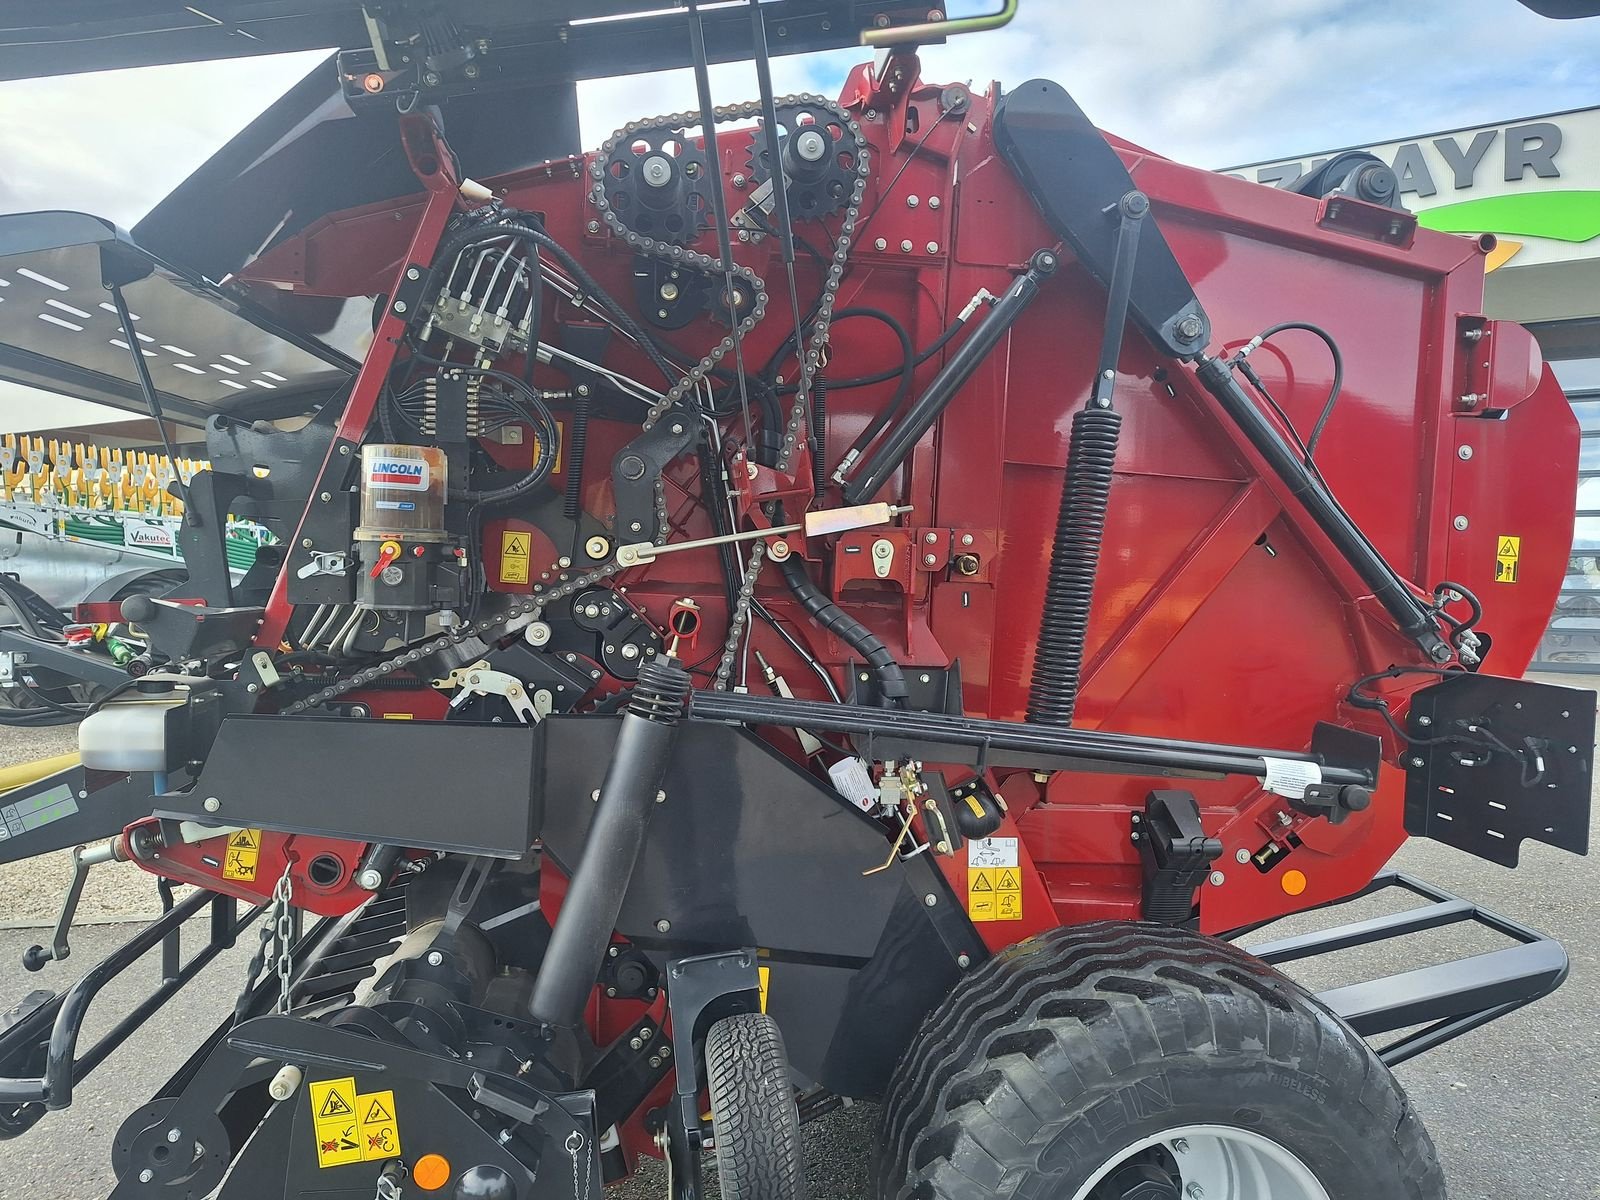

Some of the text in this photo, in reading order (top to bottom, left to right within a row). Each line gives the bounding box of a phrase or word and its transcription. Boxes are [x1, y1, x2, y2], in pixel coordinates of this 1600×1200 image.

[372, 463, 422, 475] LINCOLN
[130, 531, 169, 542] Vakutec
[1266, 1070, 1328, 1105] TUBELESS
